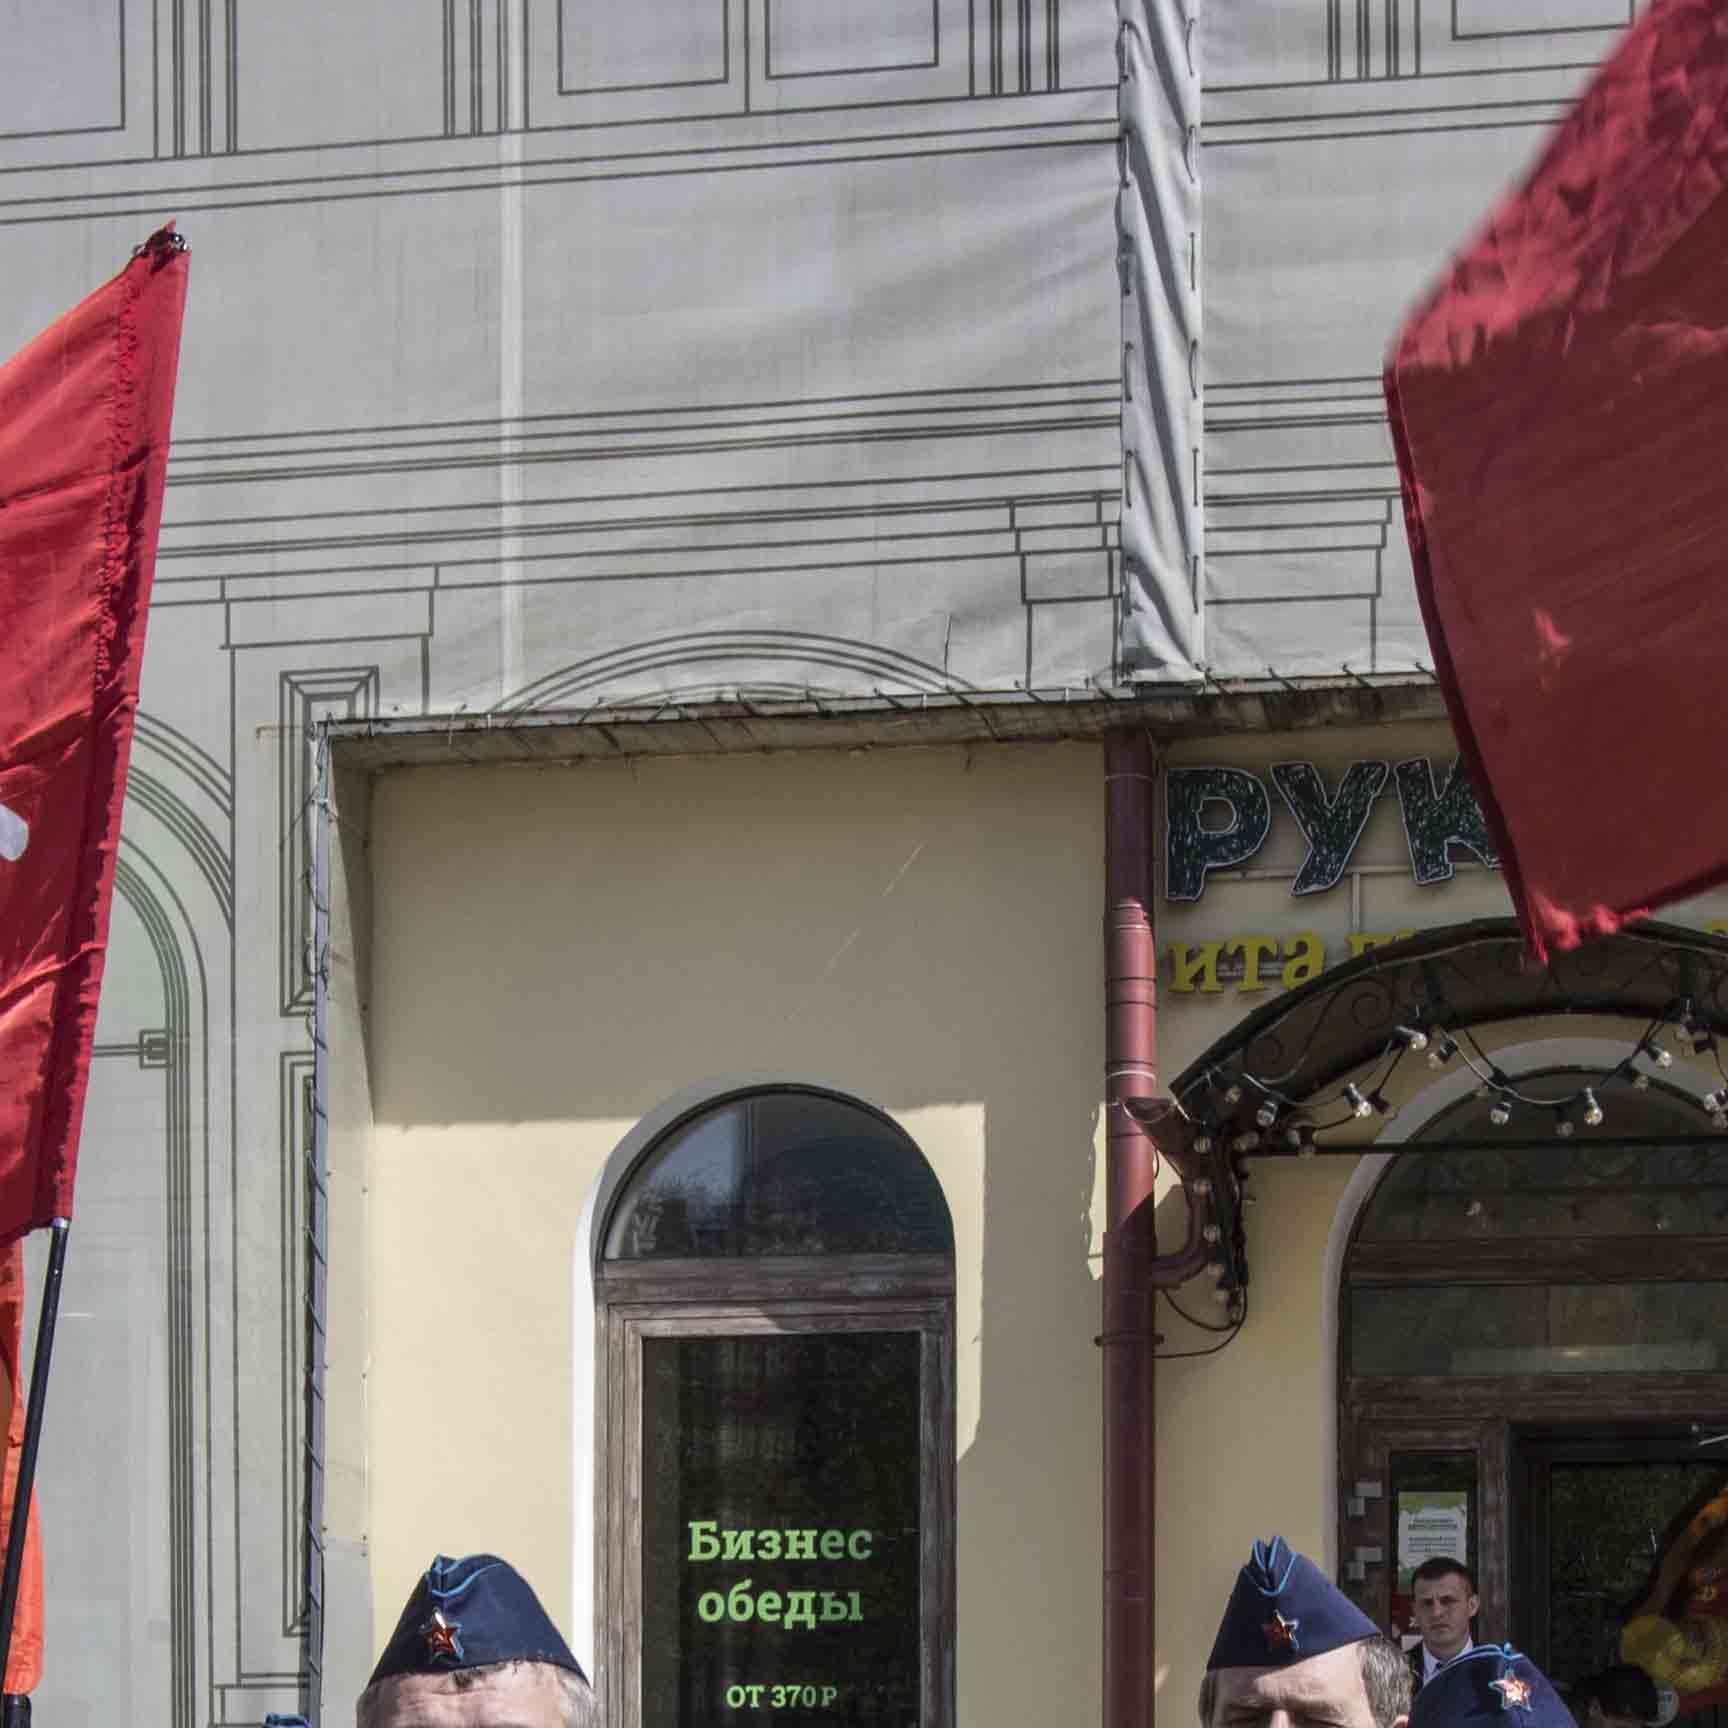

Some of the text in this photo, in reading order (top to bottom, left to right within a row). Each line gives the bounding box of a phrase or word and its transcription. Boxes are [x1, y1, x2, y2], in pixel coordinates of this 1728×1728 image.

[687, 1521, 874, 1560] Бизнес
[697, 1579, 865, 1629] обеды
[725, 1686, 765, 1709] ОТ
